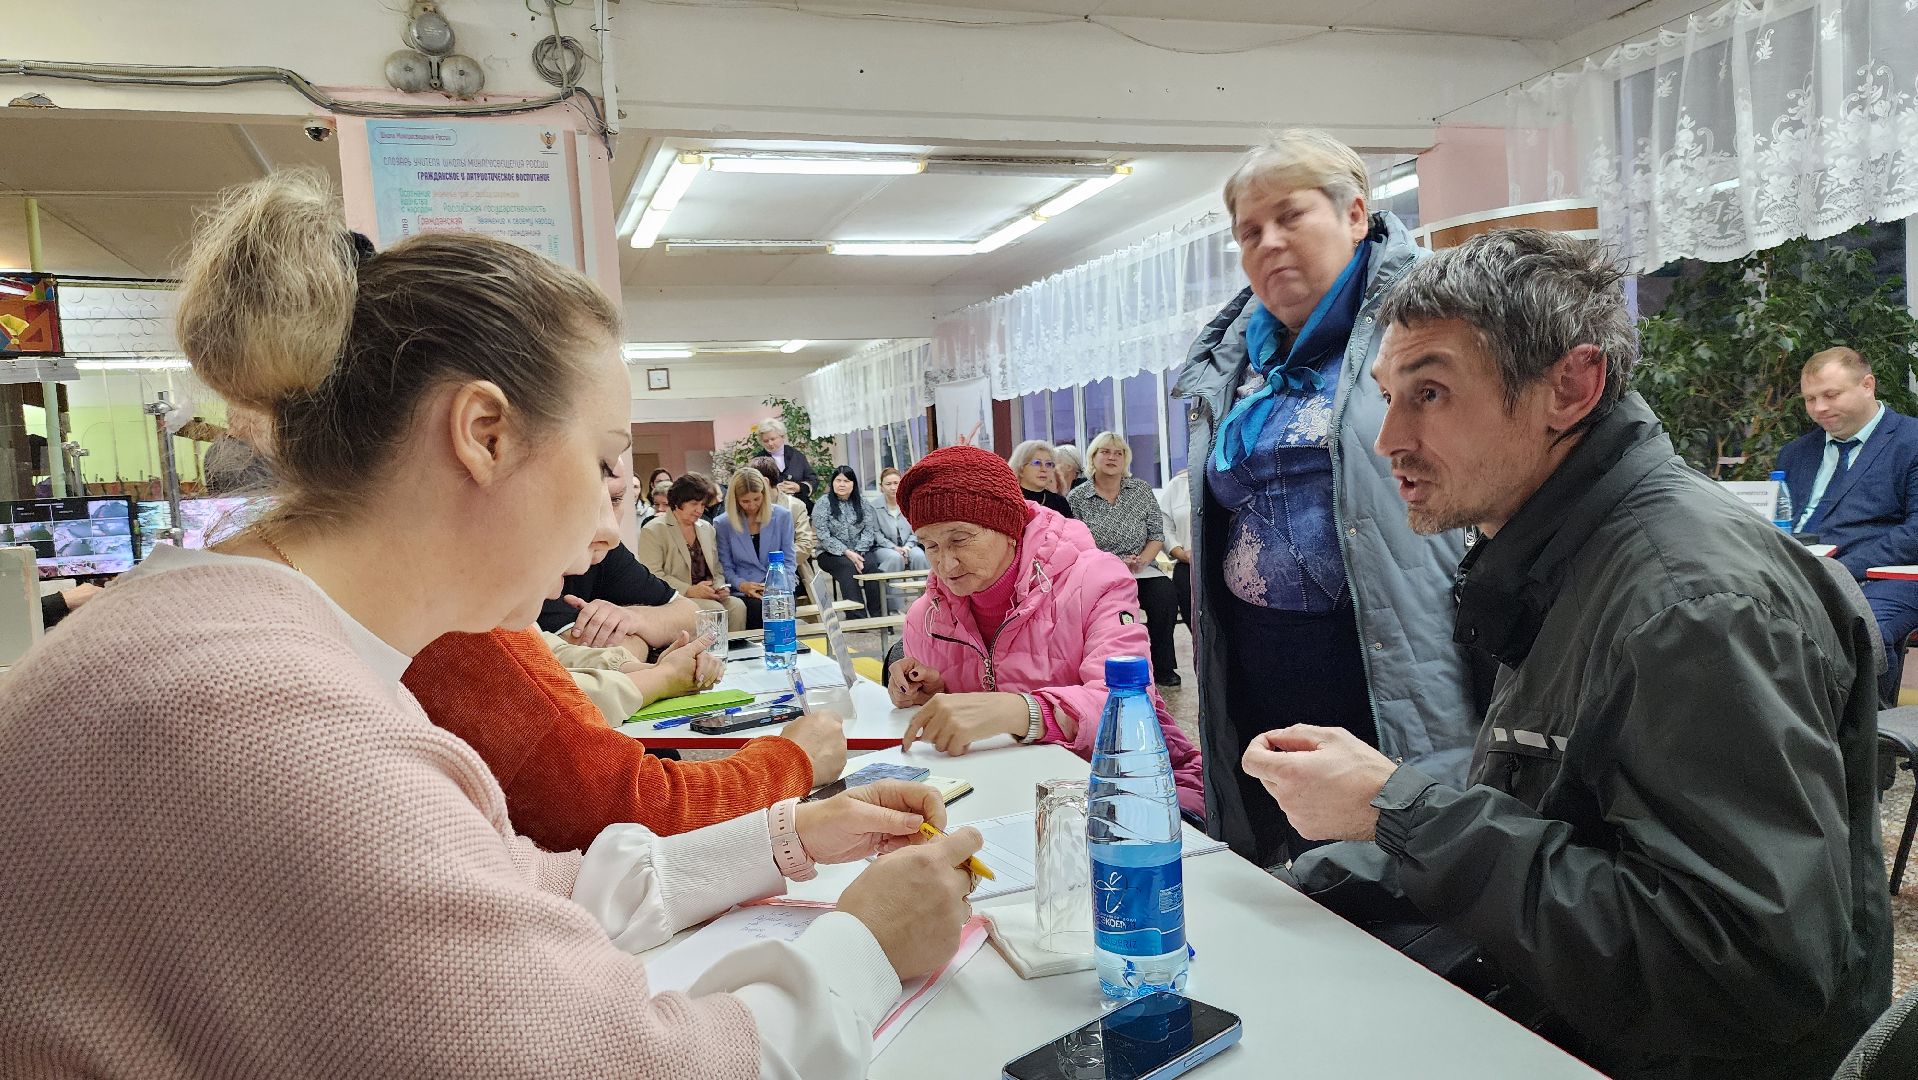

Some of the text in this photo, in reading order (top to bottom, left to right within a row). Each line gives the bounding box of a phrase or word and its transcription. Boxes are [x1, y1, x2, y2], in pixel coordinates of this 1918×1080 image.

[383, 156, 412, 166] СЛОВАРЬ
[413, 157, 441, 167] УЧИТЕЛЯ
[417, 171, 550, 182] ГРАЖДАНСКОЕ И ПАТРИОТИЧЕСКОЕ ВОСПИТАНИЕ
